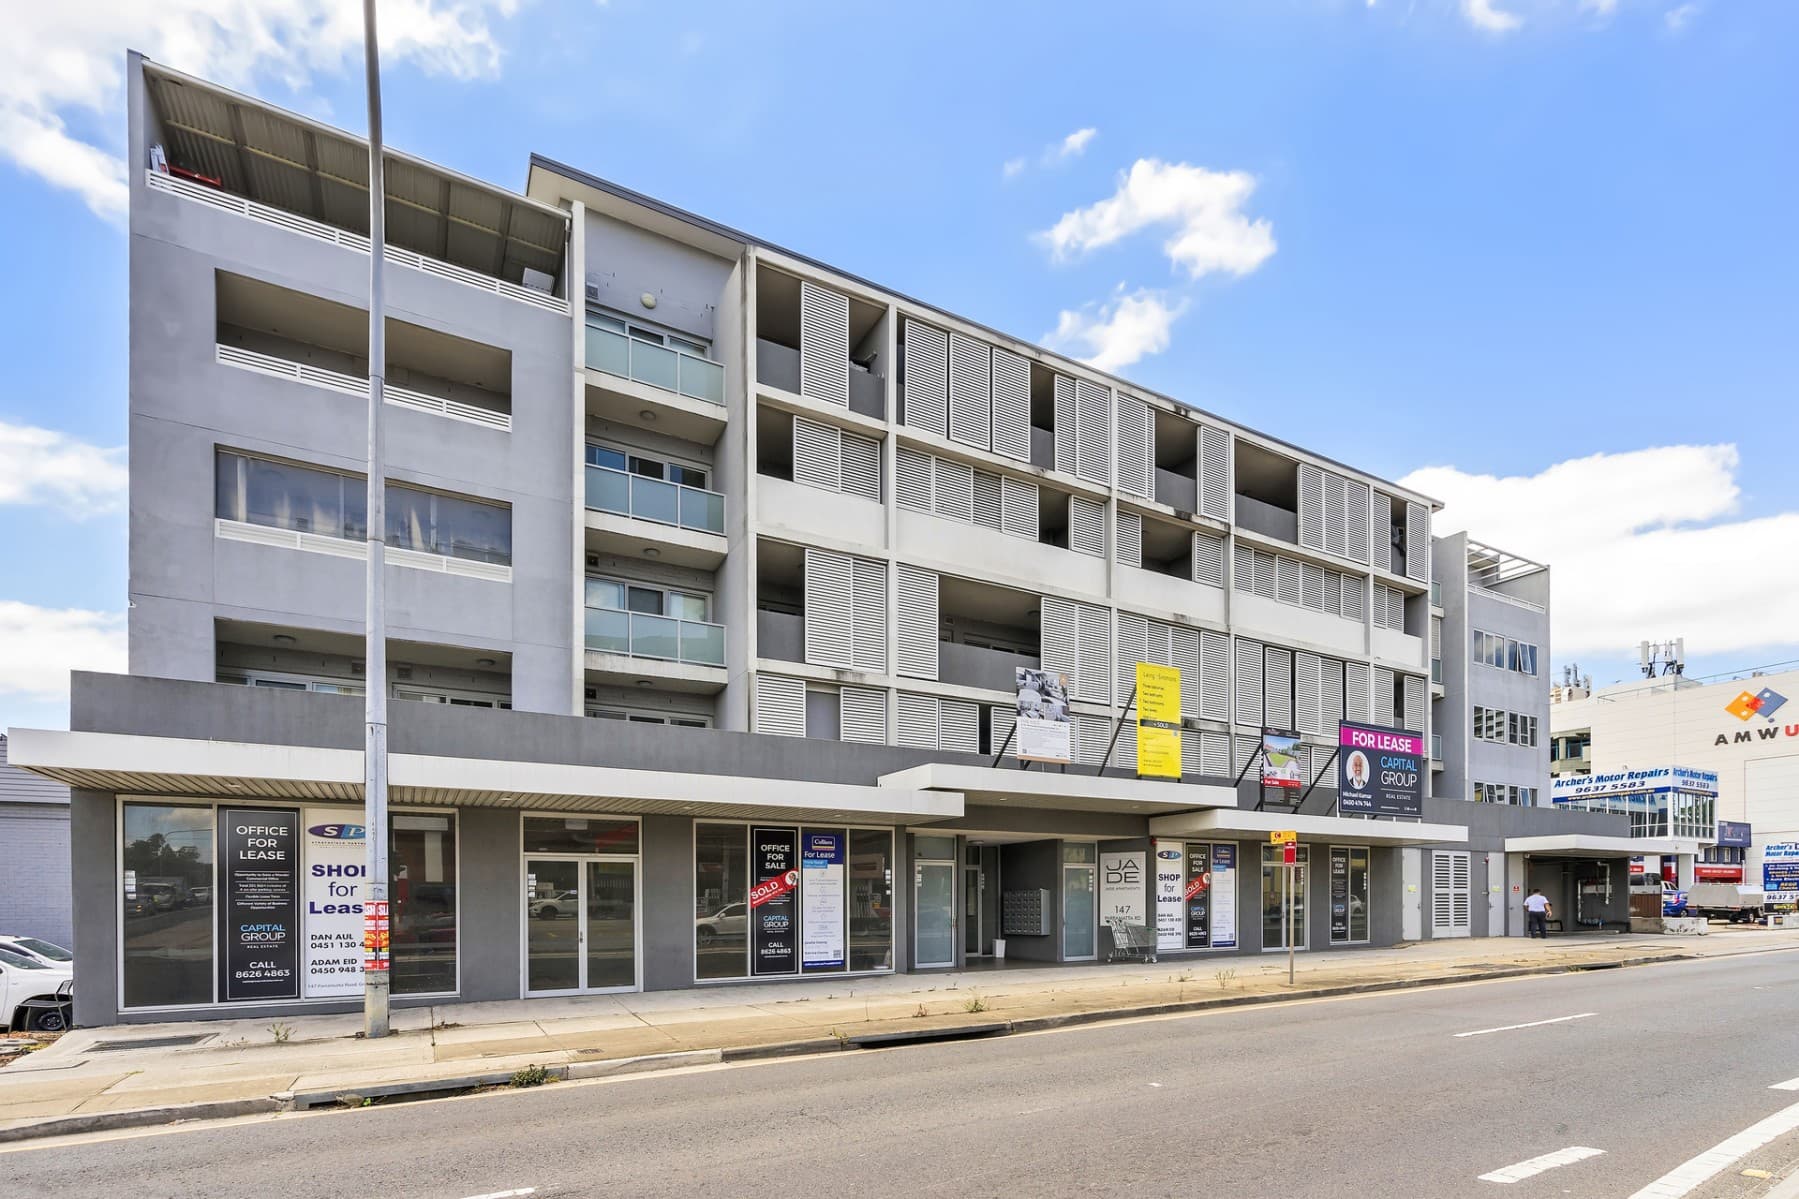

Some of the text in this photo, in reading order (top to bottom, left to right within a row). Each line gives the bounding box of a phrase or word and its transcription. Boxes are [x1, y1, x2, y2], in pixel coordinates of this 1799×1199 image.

[1714, 724, 1799, 746] AMWU
[1353, 731, 1412, 752] FOR LEASE
[1380, 756, 1417, 772] CAPITAL
[1381, 771, 1417, 787] GROUP
[1554, 768, 1670, 788] Archer's Motor Repairs
[1575, 785, 1606, 794] 9637
[1611, 781, 1646, 790] 5583
[236, 826, 288, 836] OFFICE
[248, 838, 277, 848] FOR
[760, 844, 790, 852] OFFICE
[240, 850, 286, 860] LEASE
[767, 853, 784, 861] FOR
[816, 851, 835, 859] Lease
[1158, 873, 1181, 881] SHOP
[328, 882, 358, 897] for
[751, 881, 779, 900] SOLD
[1164, 883, 1175, 893] for
[1157, 895, 1182, 903] Lease
[309, 901, 364, 914] Leas
[1115, 905, 1131, 914] 147
[240, 924, 286, 932] CAPITAL
[241, 932, 286, 942] GROUP
[249, 961, 277, 969] CALL
[235, 969, 290, 978] 8626 4863
